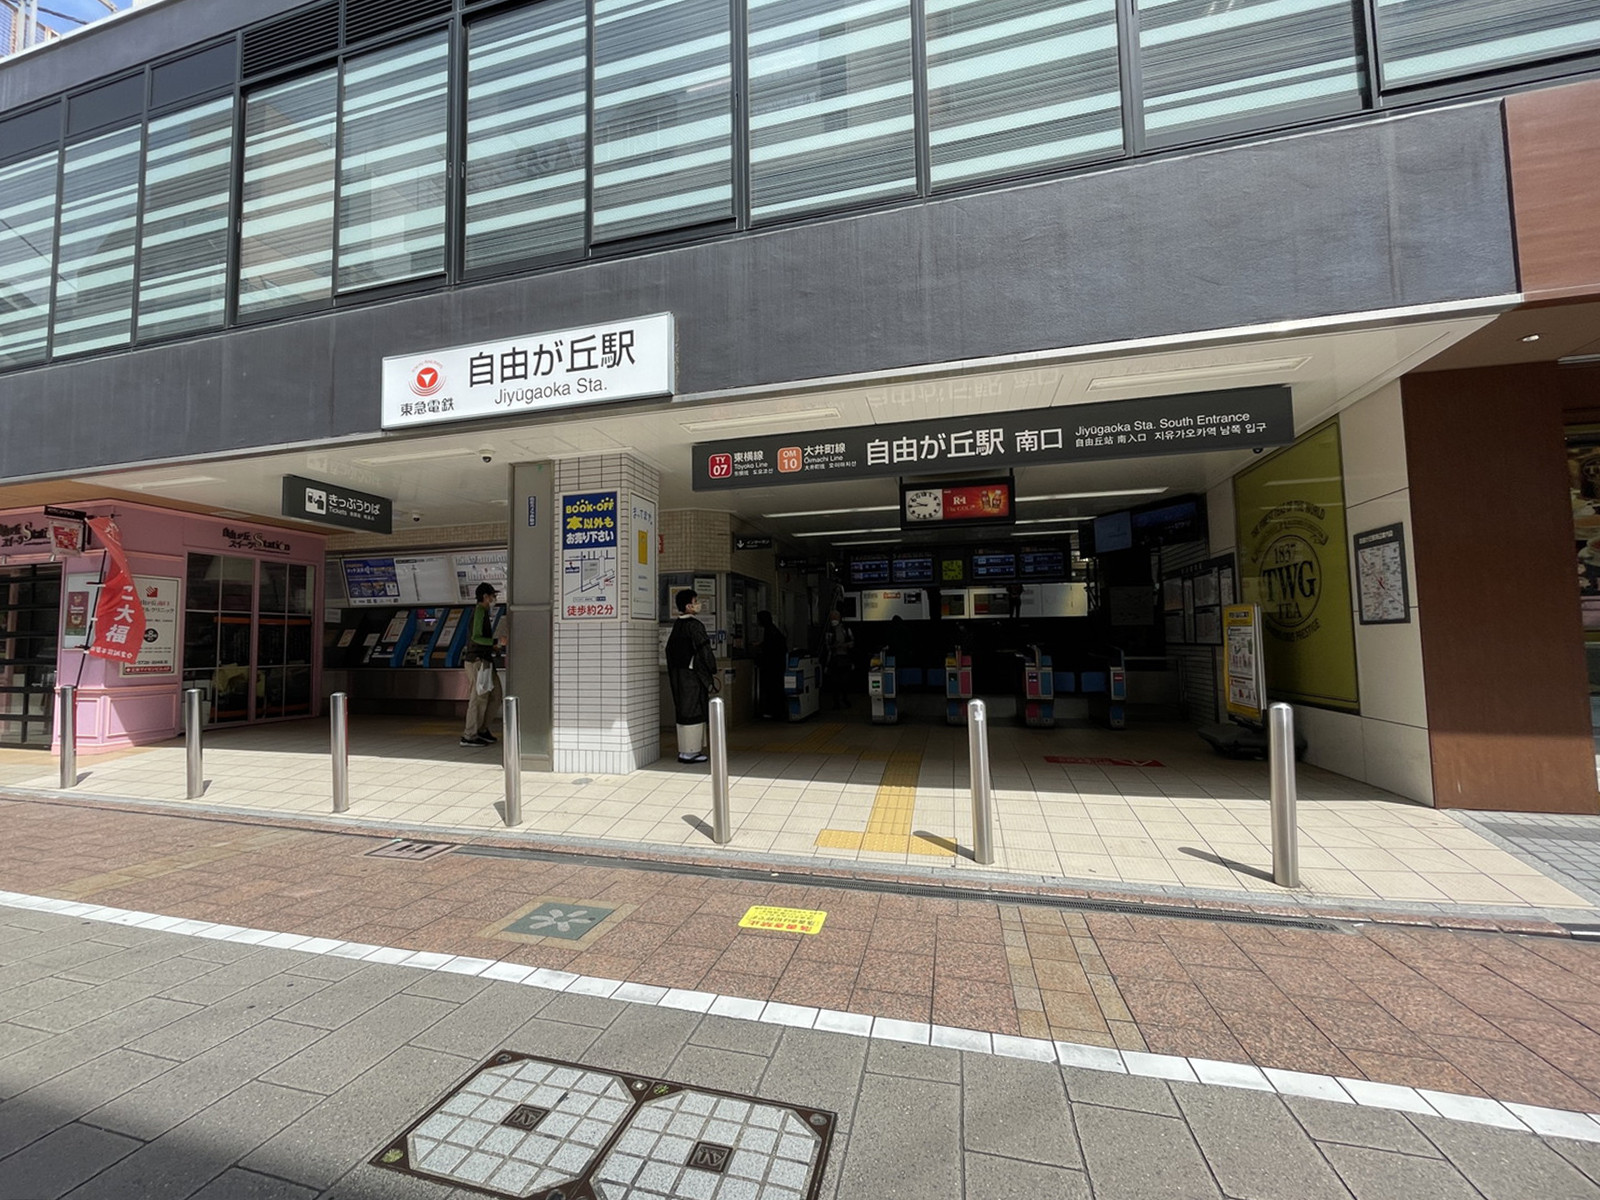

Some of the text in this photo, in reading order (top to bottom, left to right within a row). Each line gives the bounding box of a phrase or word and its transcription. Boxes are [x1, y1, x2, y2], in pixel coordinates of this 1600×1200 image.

[469, 329, 635, 388] 自由が丘駅
[494, 377, 607, 407] Jiyūgaoka Sta.
[400, 398, 454, 416] 東急電鉄
[1075, 413, 1250, 437] Jiyūgaoka Sta. South Entrance
[1154, 427, 1217, 441] 지유가오카역
[1245, 422, 1267, 434] 입구
[866, 428, 1063, 466] 自由が丘駅 南口
[1075, 434, 1147, 448] 自由丘站 南入口
[734, 450, 764, 462] 東横線
[783, 450, 797, 458] OM
[803, 442, 846, 456] 大井町線
[715, 456, 726, 464] TY
[755, 461, 768, 469] Line
[783, 458, 797, 469] 10
[830, 454, 844, 462] Line
[713, 465, 728, 476] 07
[328, 494, 380, 515] きっぷうりば
[566, 515, 614, 530] 本以外も
[253, 532, 291, 551] Station
[566, 530, 614, 545] お売り下さい
[1263, 560, 1317, 602] TWG
[567, 604, 614, 616] 徒歩約2分
[1278, 602, 1302, 619] TEA
